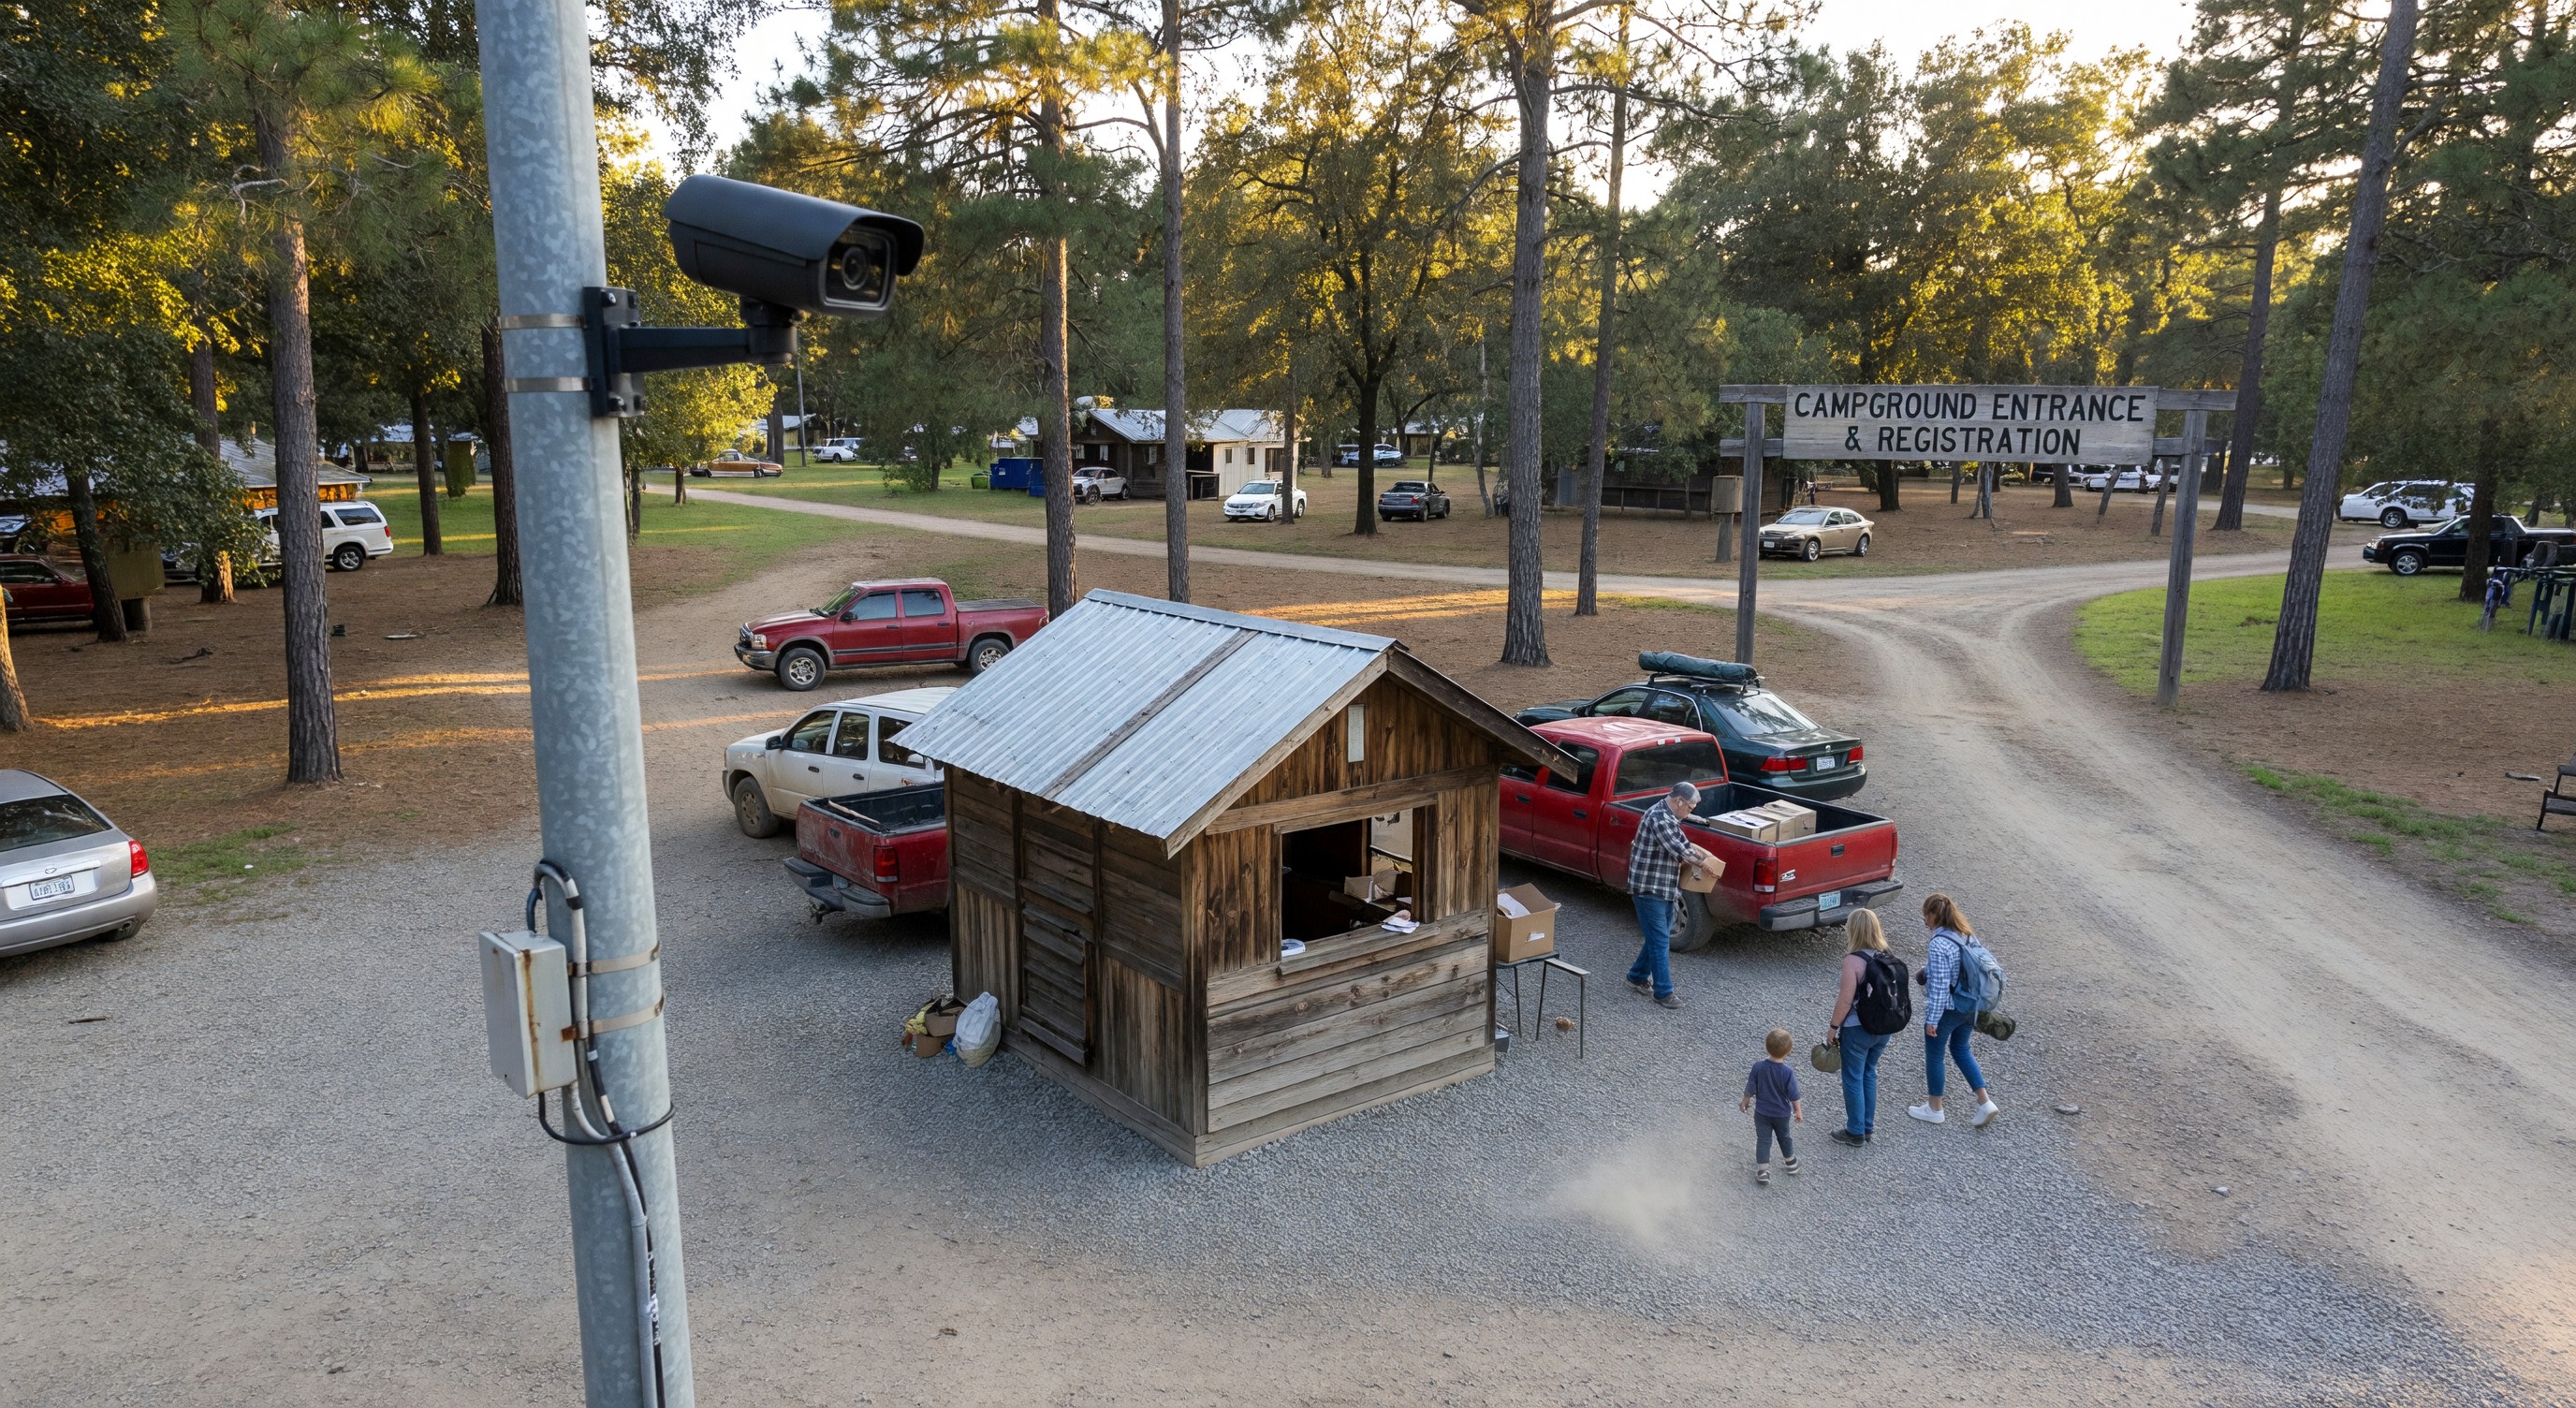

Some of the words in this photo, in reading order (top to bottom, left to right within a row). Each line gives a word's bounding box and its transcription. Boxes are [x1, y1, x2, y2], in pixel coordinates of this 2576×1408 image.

[1794, 391, 1977, 419] CAMPGROUND
[1992, 392, 2146, 422] ENTRANCE
[1844, 425, 1863, 452] &
[1878, 426, 2081, 456] REGISTRATION
